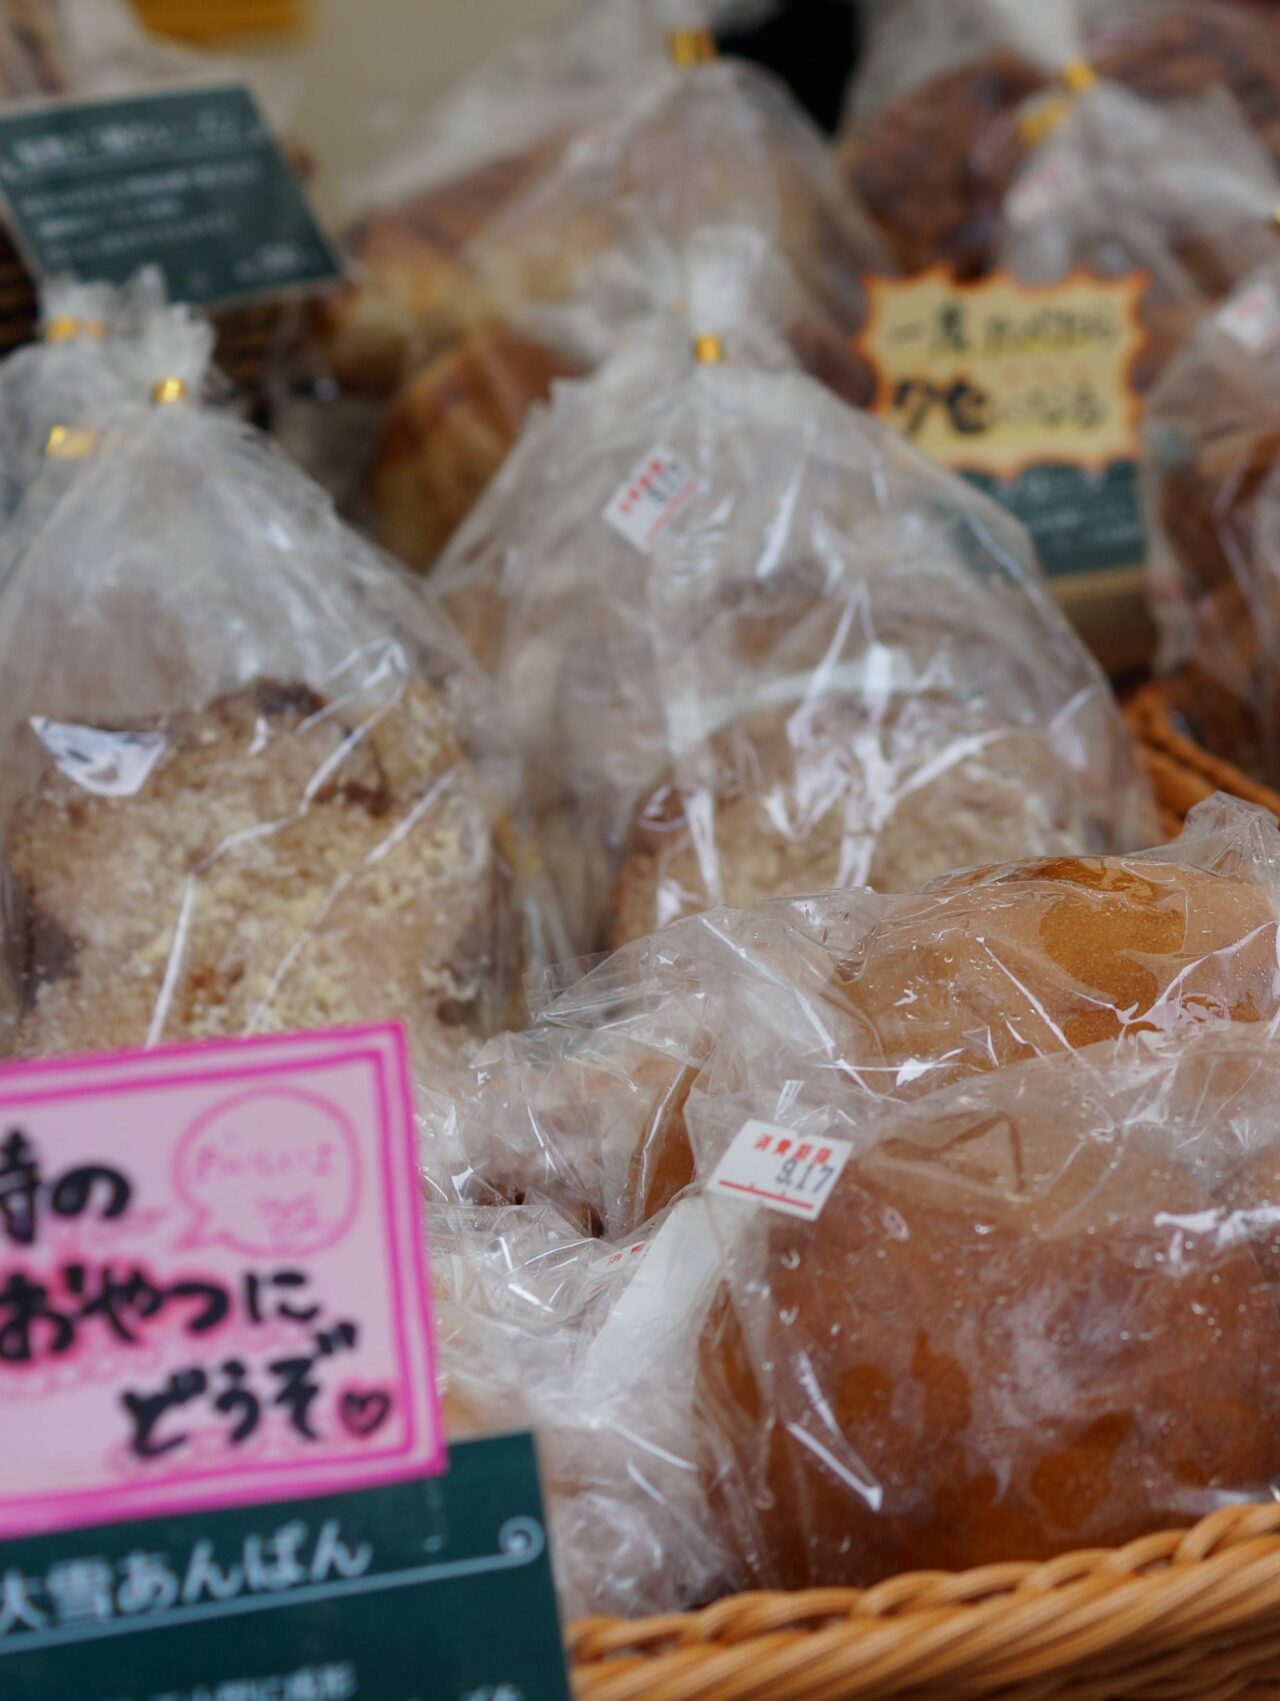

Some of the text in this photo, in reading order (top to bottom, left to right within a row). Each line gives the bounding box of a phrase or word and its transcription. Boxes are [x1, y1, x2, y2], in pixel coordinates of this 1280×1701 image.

[0, 1264, 321, 1362] おやつに
[121, 1321, 358, 1458] どうぞ
